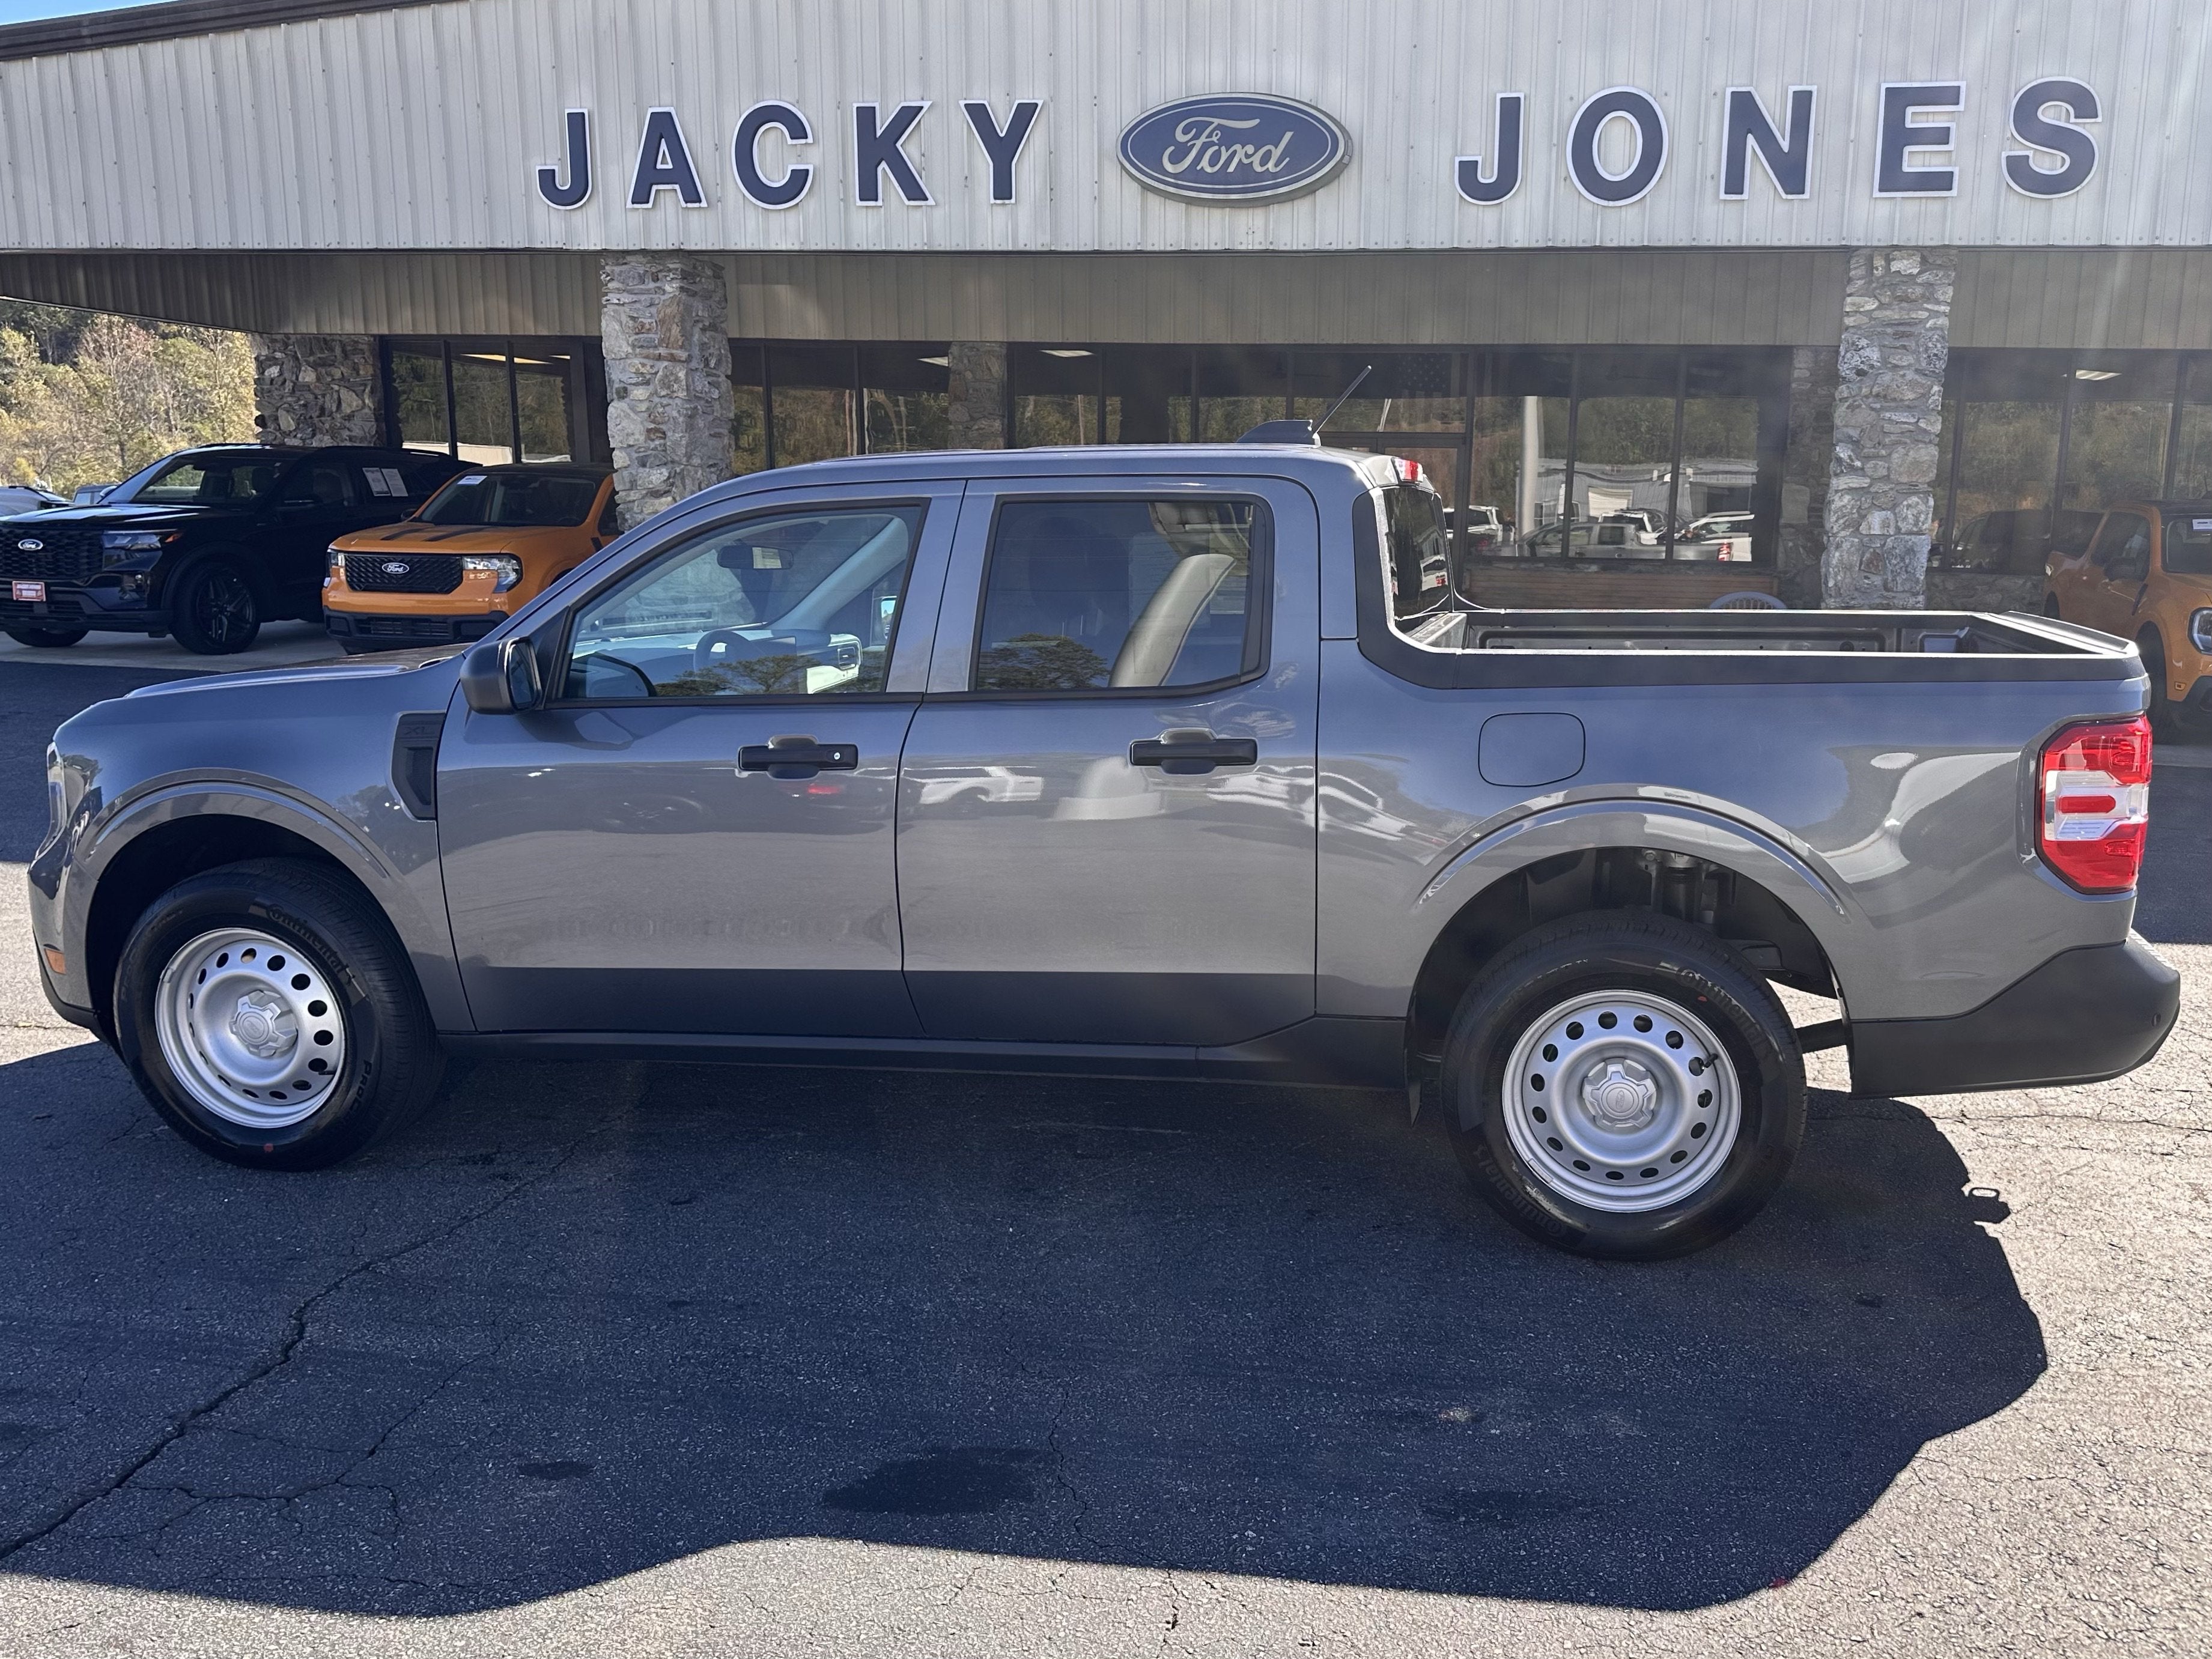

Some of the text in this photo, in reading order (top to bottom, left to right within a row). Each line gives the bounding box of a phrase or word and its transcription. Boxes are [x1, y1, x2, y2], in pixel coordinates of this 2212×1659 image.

[536, 77, 2103, 210] JACKY Ford JONES
[266, 903, 349, 974] Continental
